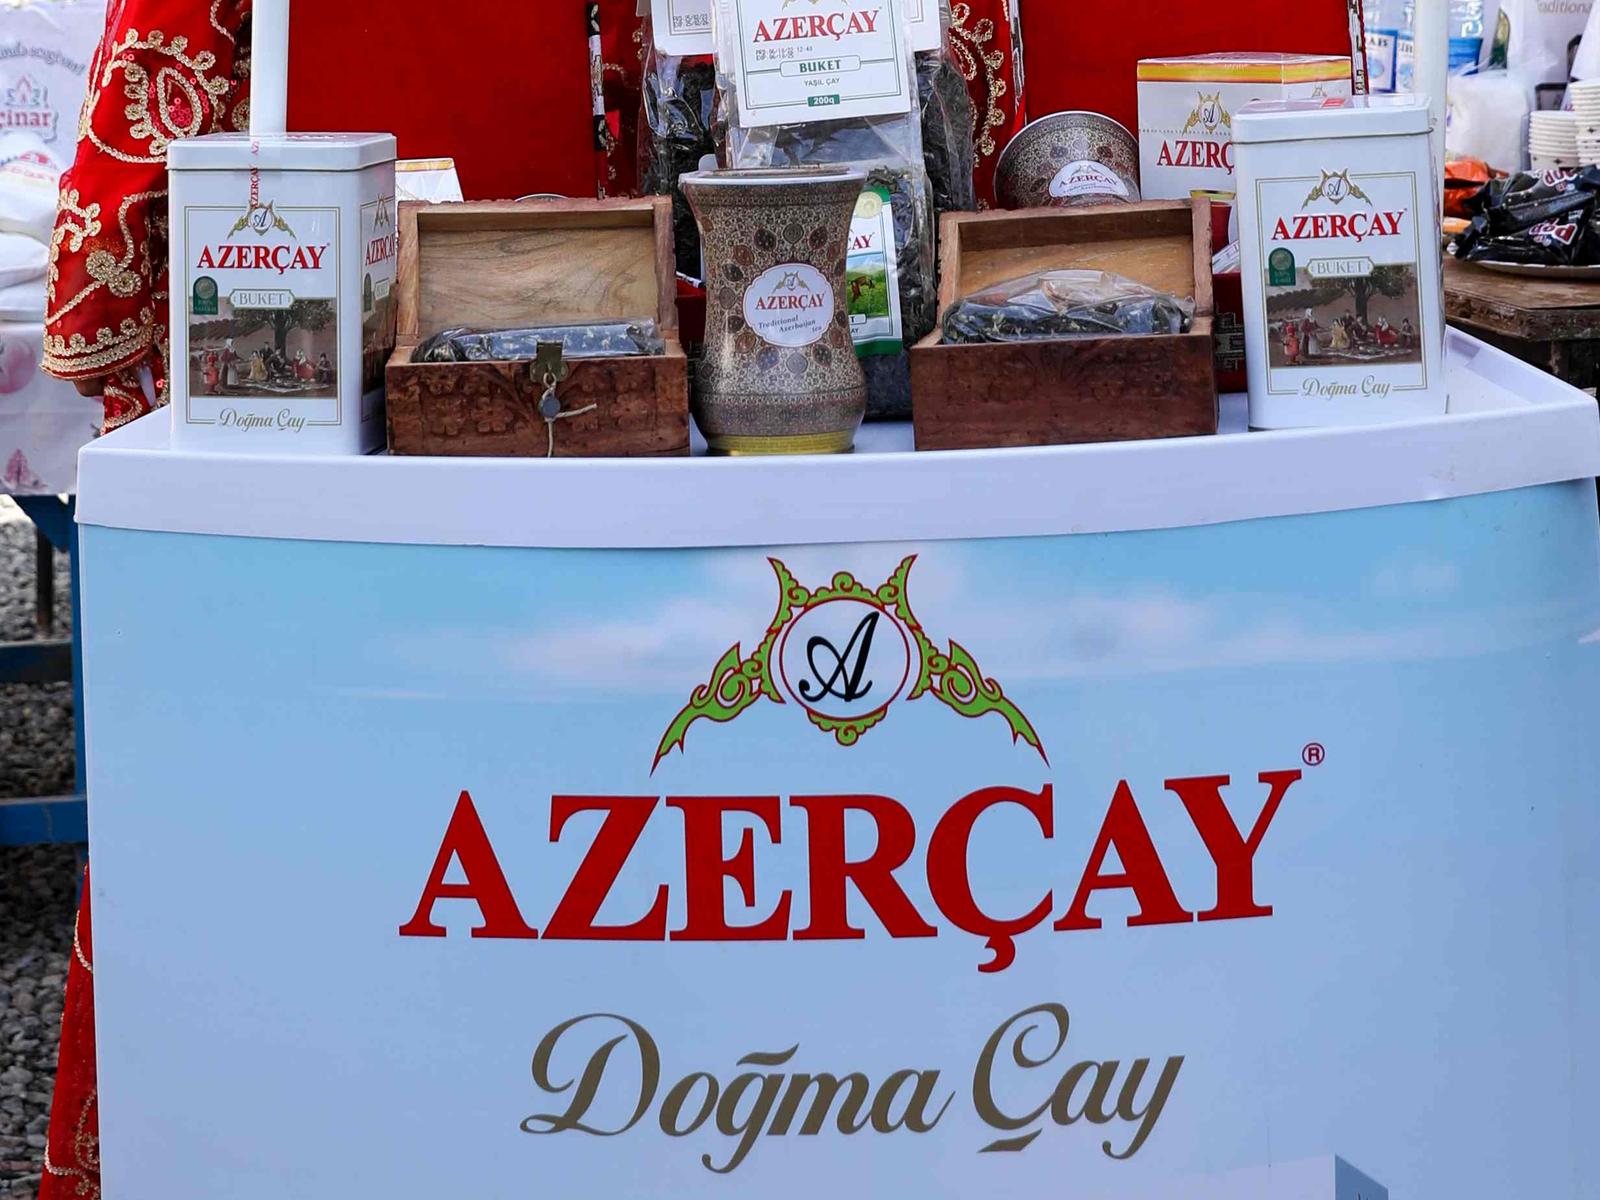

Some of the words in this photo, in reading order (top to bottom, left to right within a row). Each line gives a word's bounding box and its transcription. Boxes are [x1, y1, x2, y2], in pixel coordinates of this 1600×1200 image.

[752, 9, 879, 43] AZERÇAY
[799, 59, 842, 73] BUKET
[826, 78, 840, 86] ÇAY
[1156, 139, 1235, 174] AZERÇ
[1271, 211, 1404, 243] AZERÇAY
[197, 245, 327, 275] AZERÇAY
[1316, 260, 1364, 275] BUKET
[239, 292, 285, 306] BUKET
[755, 293, 825, 312] AZERÇAY
[1302, 377, 1358, 400] Doğma
[1361, 375, 1391, 398] Çay
[219, 408, 274, 432] Doğma
[277, 408, 306, 433] Çay
[399, 767, 1303, 973] AZERÇAY
[519, 1012, 956, 1175] Doğma
[971, 1002, 1186, 1160] Çay
